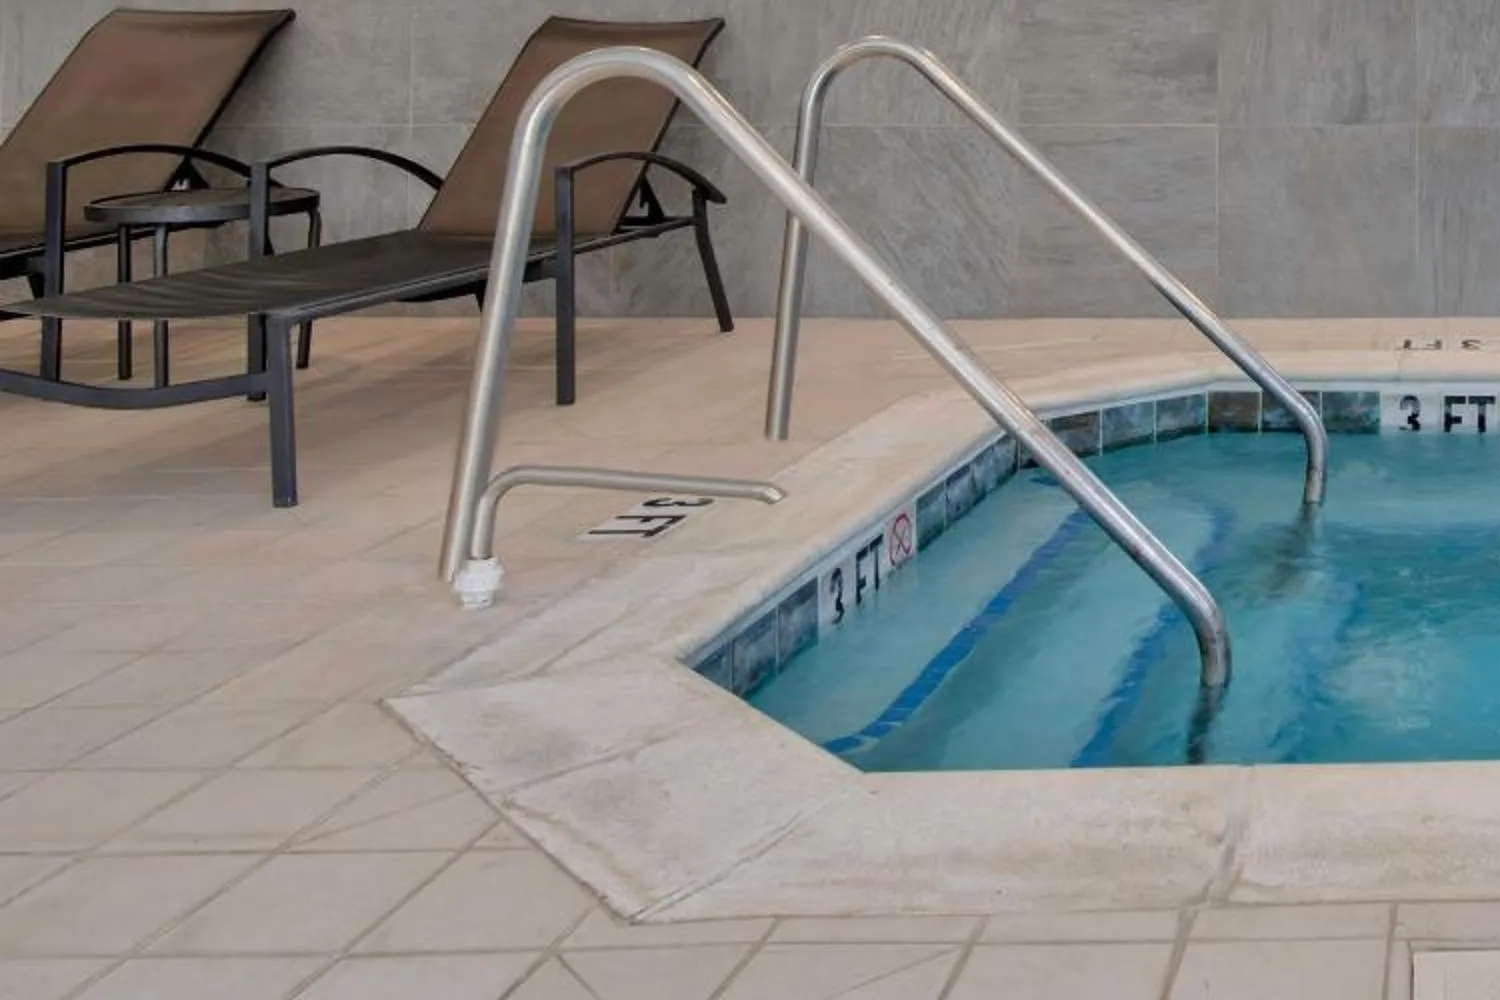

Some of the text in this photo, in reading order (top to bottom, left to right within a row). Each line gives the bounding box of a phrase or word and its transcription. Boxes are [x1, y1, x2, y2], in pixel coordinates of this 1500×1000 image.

[1400, 395, 1496, 434] 3 FT
[588, 514, 687, 537] FT
[830, 533, 884, 624] 3 FT
